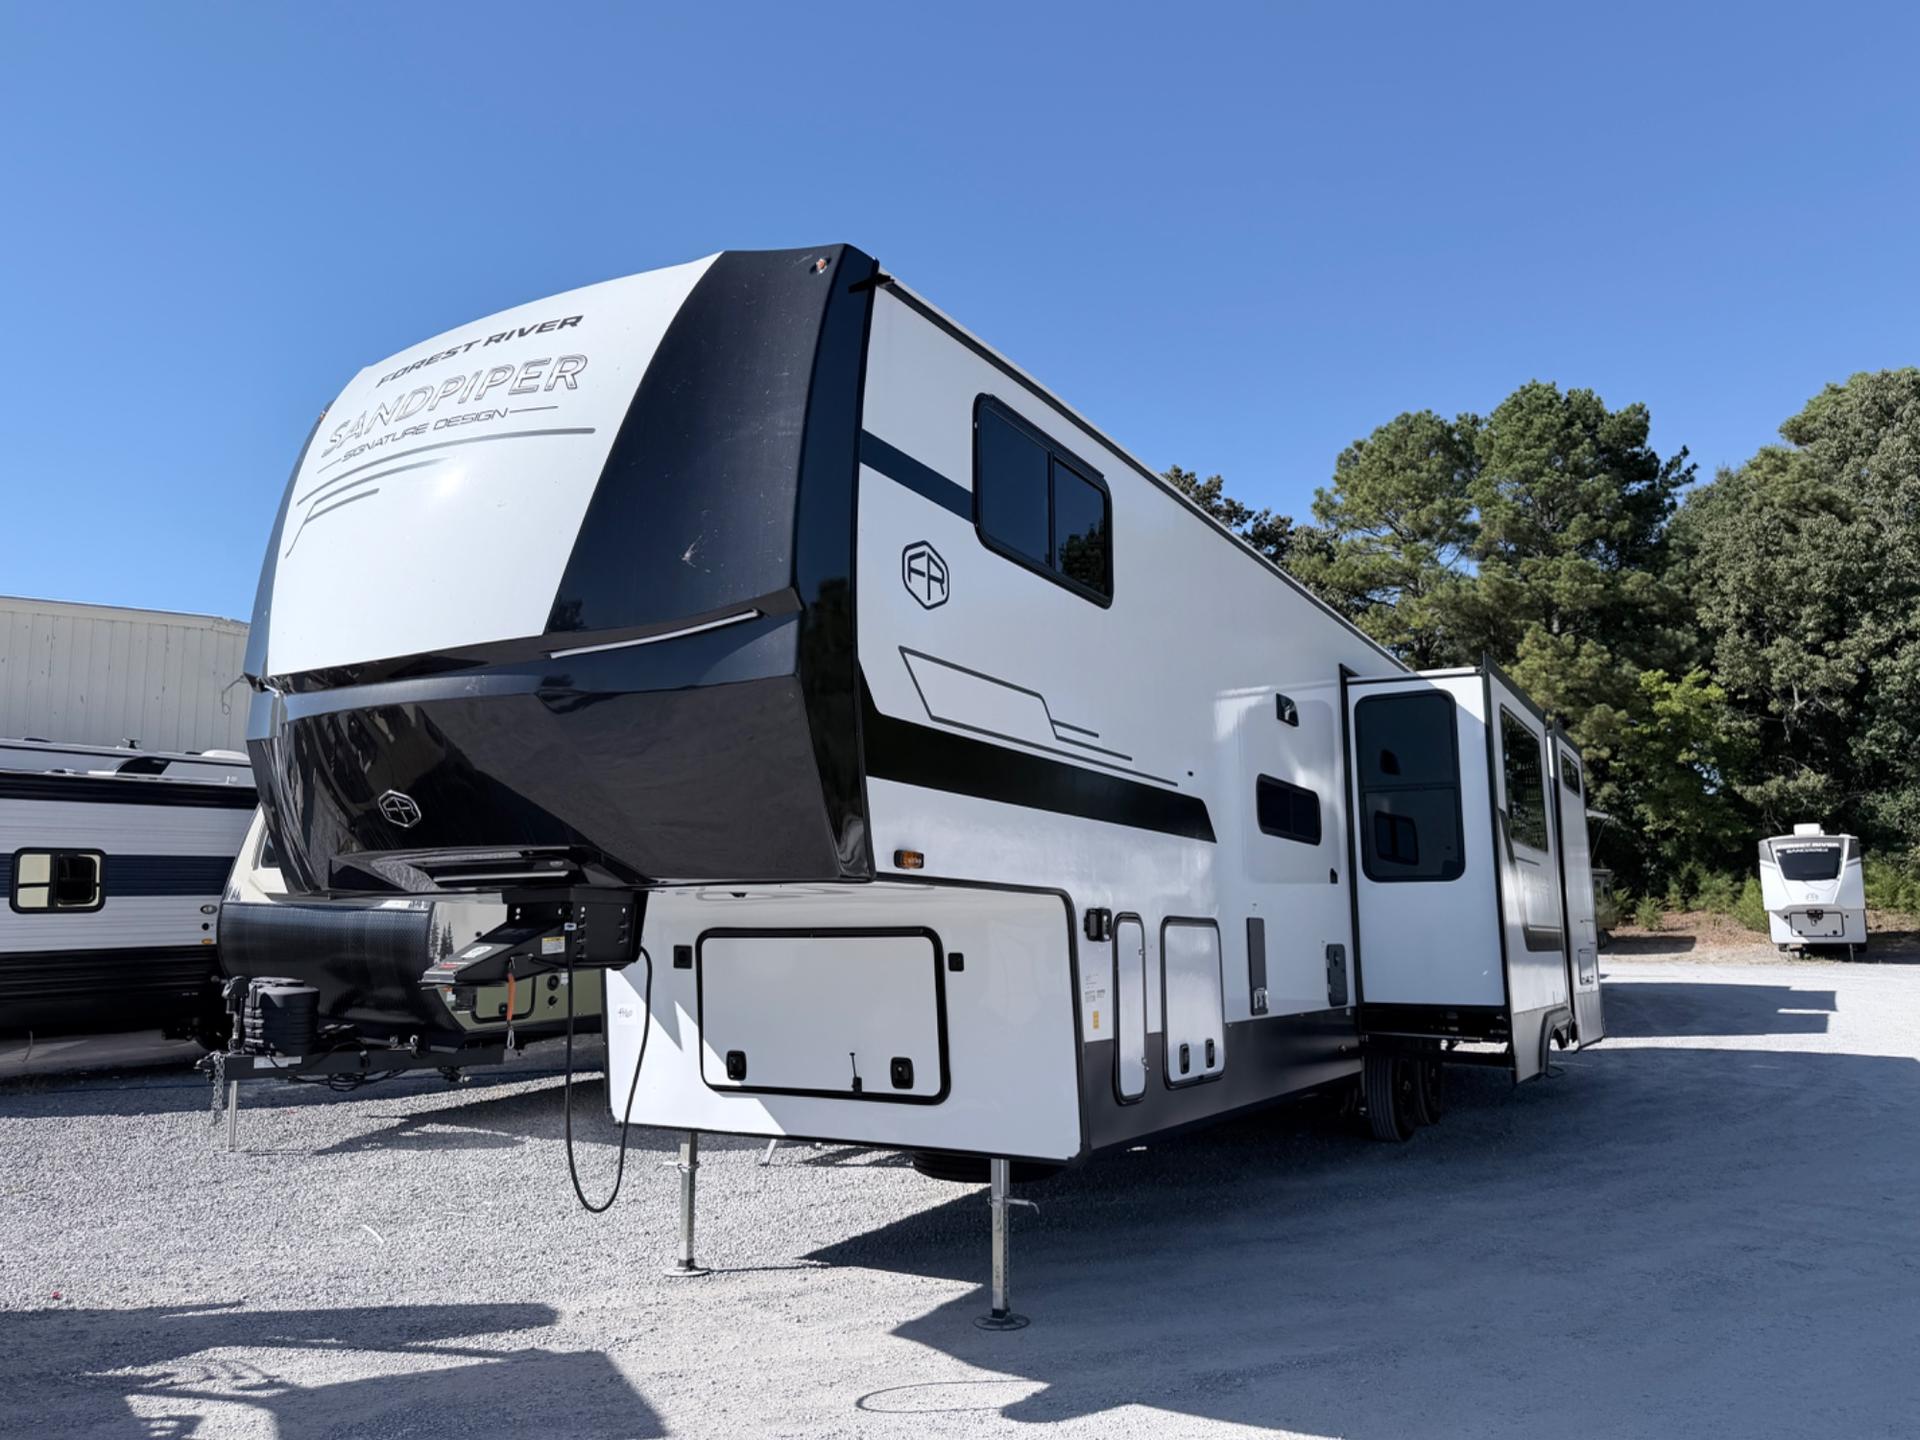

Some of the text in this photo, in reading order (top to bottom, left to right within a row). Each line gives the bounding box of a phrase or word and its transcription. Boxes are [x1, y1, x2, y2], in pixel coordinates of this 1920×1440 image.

[375, 314, 584, 389] FOREST RIVER
[321, 353, 588, 458] SANDPIPER
[341, 407, 510, 463] SIGNATURE DESIGN
